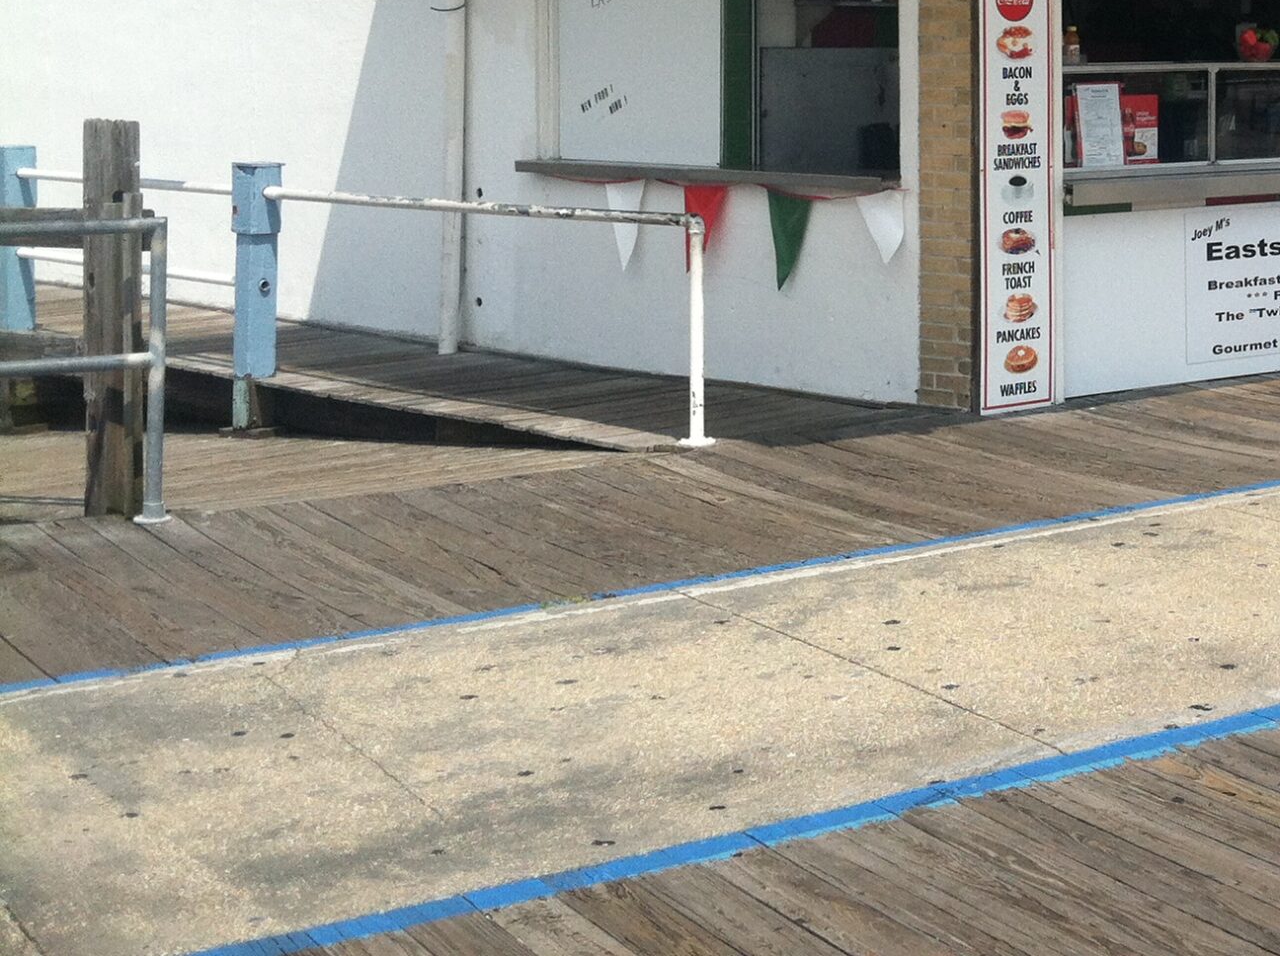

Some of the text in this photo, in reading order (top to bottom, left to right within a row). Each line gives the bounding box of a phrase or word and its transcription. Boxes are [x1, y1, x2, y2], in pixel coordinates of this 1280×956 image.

[1002, 67, 1033, 80] BACON
[1014, 80, 1021, 92] &
[1006, 92, 1029, 106] EGGS
[997, 142, 1038, 157] BREAKFAST
[993, 156, 1042, 171] SANDWICHES
[1003, 210, 1033, 225] COFFEE
[1191, 217, 1231, 242] Joey M's
[1002, 261, 1035, 276] FRENCH
[1005, 275, 1032, 290] TOAST
[1215, 311, 1245, 323] The
[996, 327, 1041, 343] PANCAKES
[1212, 339, 1278, 356] Gourmet
[1000, 380, 1037, 397] WAFFLES
